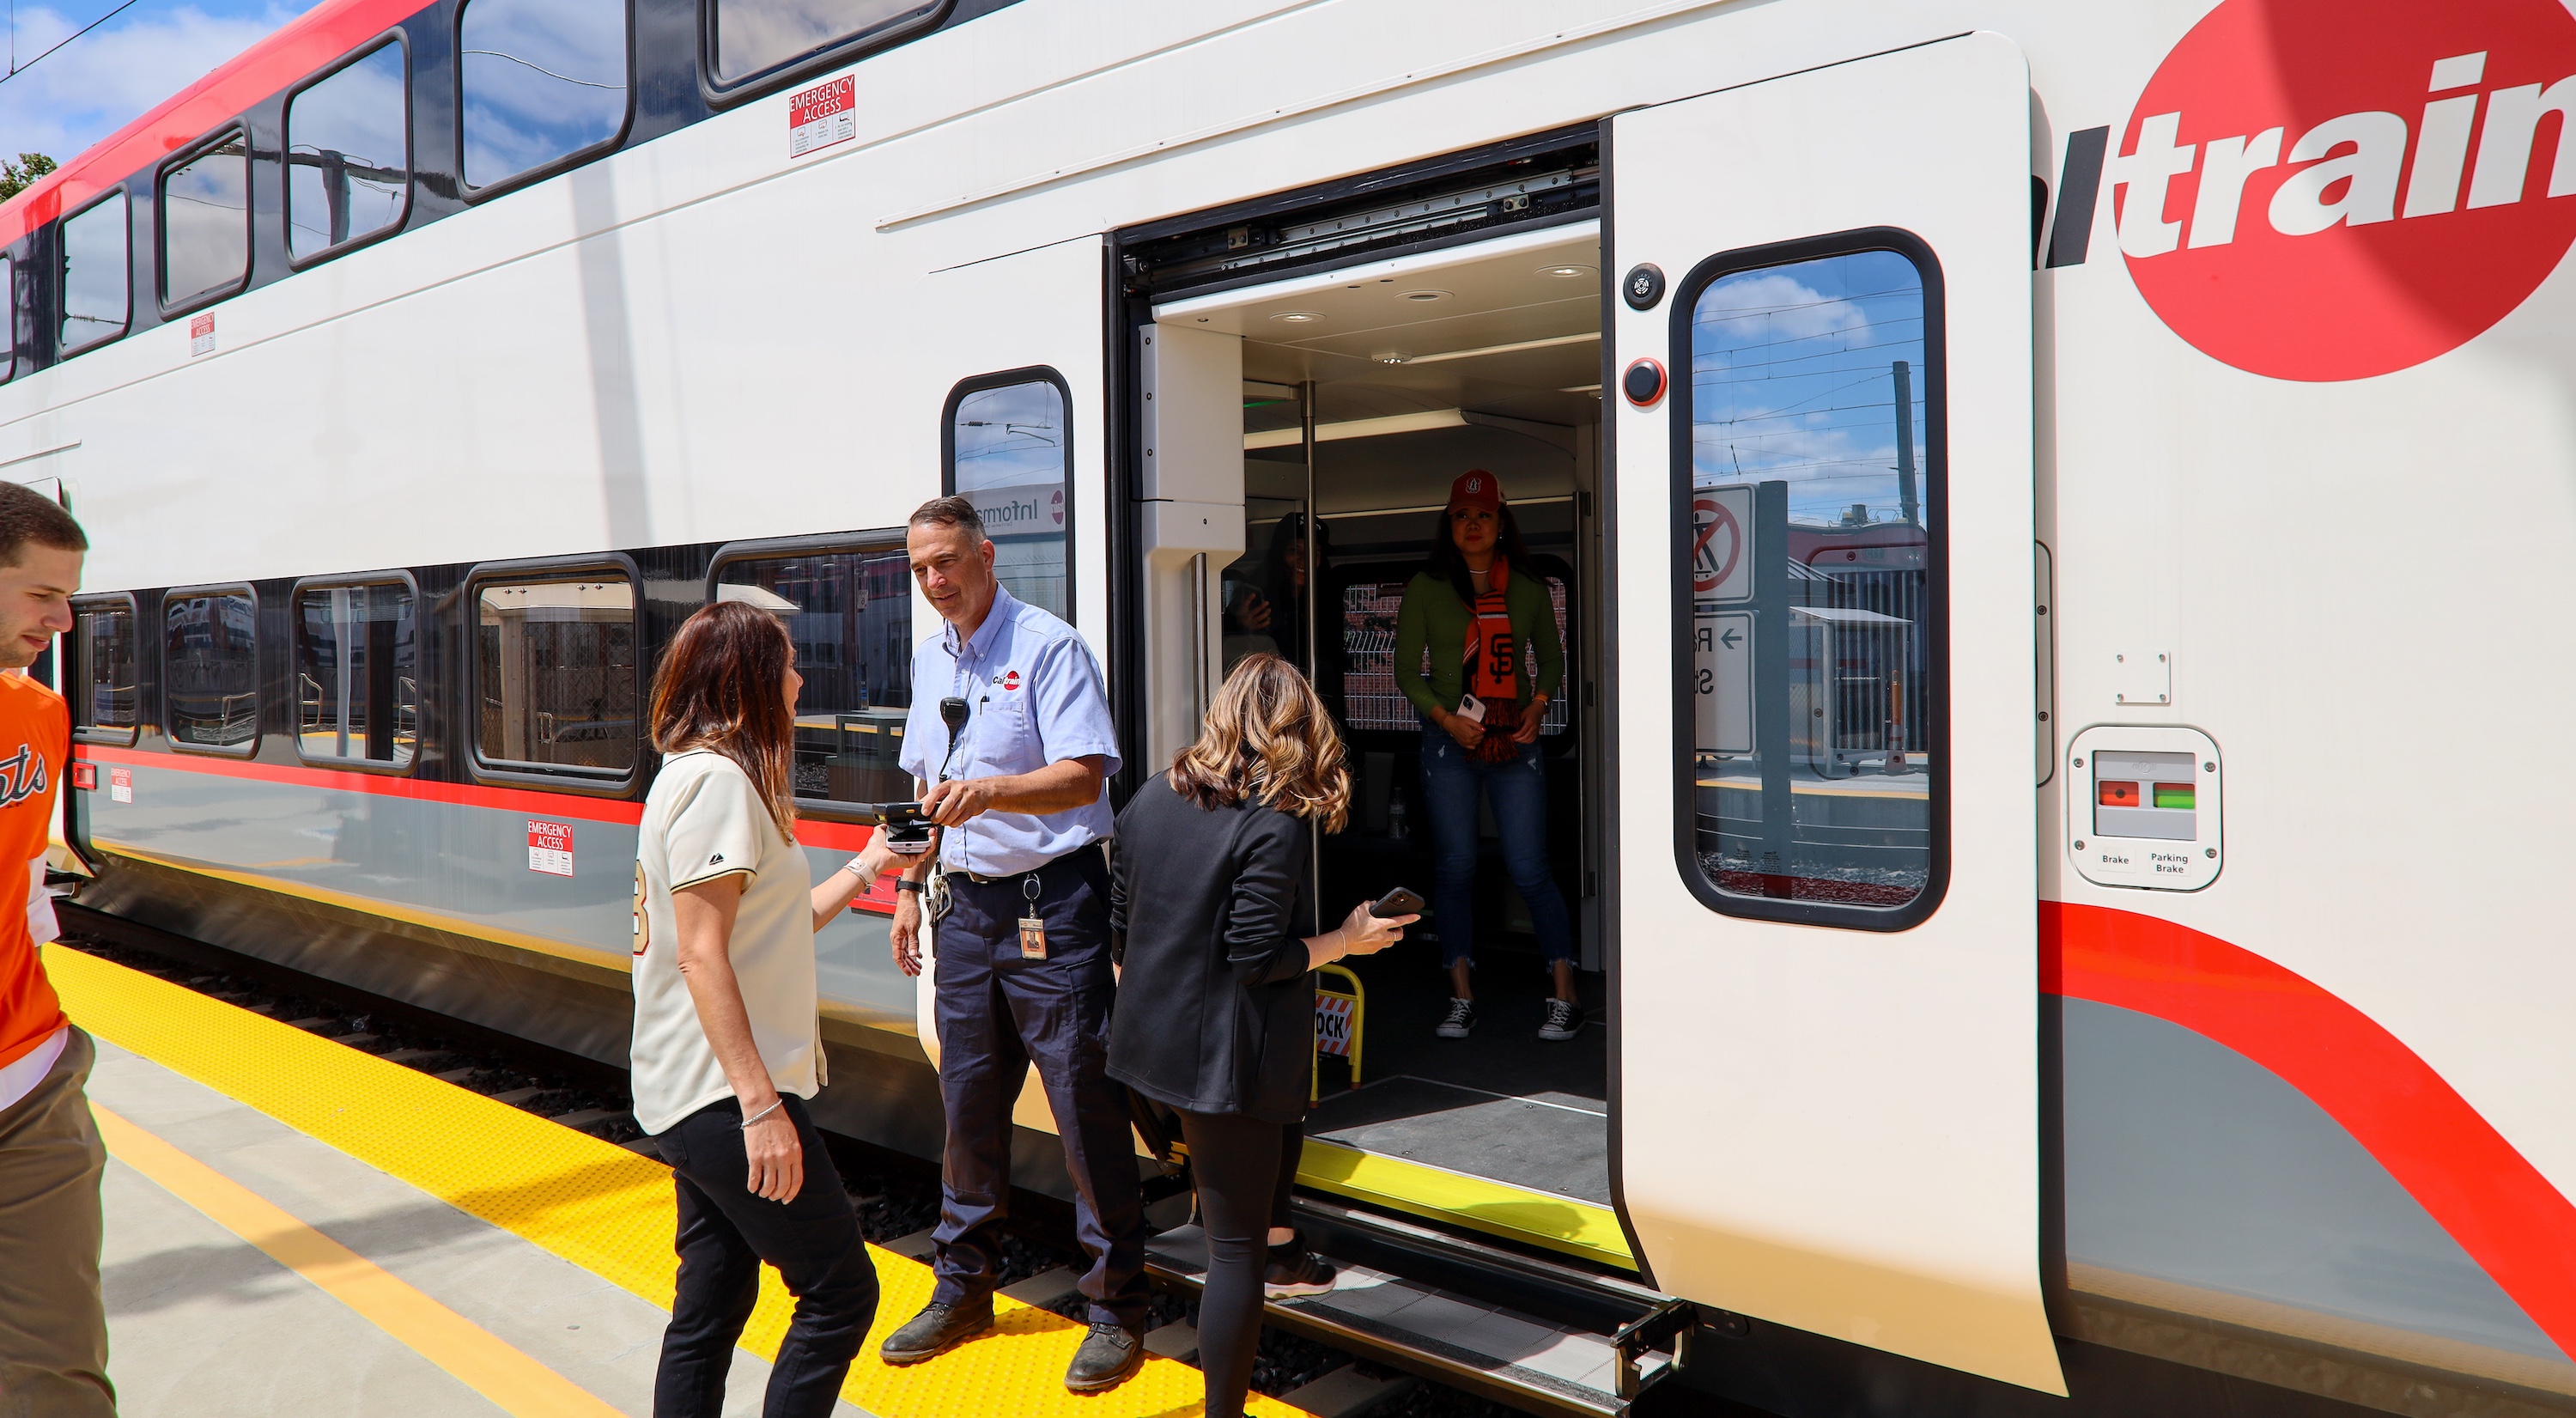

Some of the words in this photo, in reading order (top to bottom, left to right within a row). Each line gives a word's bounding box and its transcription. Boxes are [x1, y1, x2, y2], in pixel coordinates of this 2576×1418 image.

[790, 76, 854, 113] EMERGENCY
[803, 96, 841, 124] ACCESS
[2032, 51, 2576, 271] ltrain
[1490, 634, 1514, 684] SF
[993, 676, 1020, 686] Caltrain
[528, 821, 571, 838] EMERGENCY
[537, 835, 564, 850] ACCESS
[2102, 855, 2129, 865] Brake
[2151, 853, 2188, 864] Parking
[2156, 864, 2184, 873] Brake
